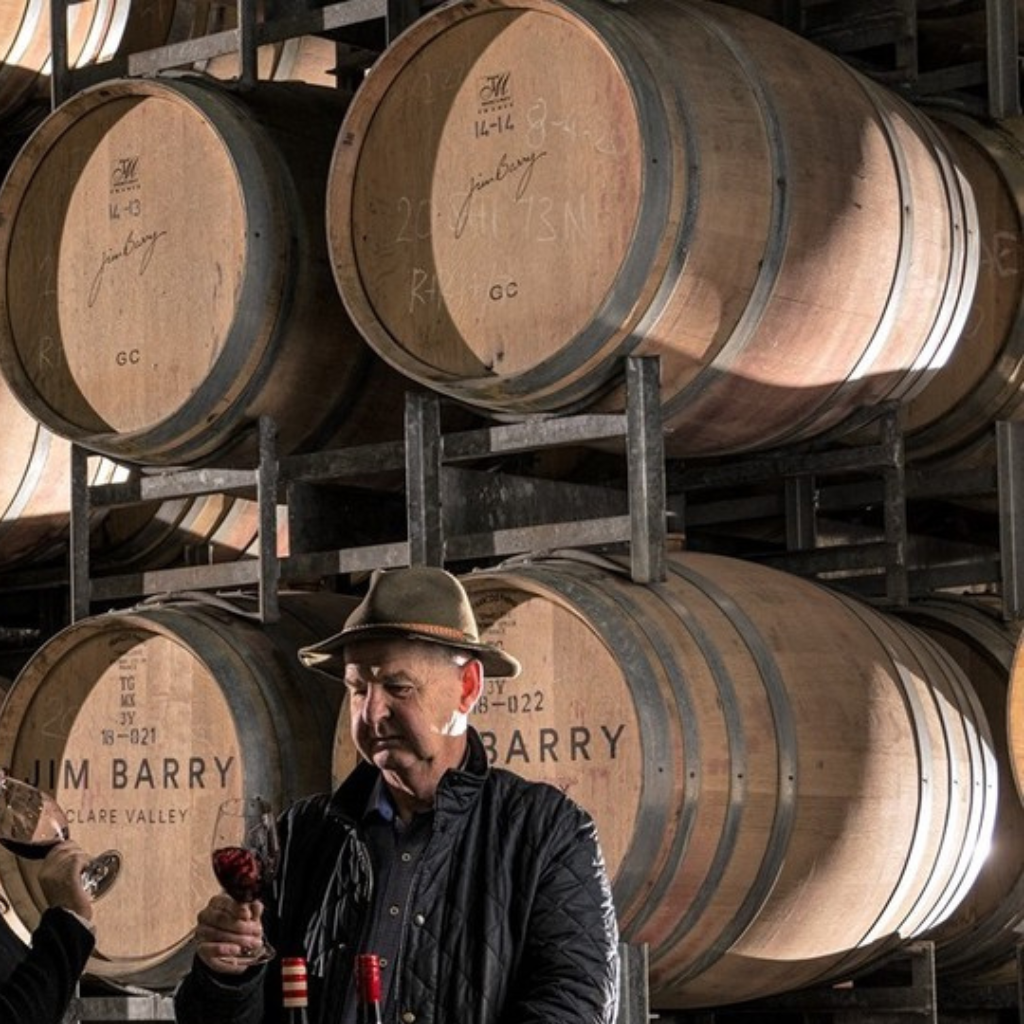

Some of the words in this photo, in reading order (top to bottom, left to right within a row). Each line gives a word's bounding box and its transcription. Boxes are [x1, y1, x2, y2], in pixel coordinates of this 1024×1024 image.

[489, 282, 519, 301] GC
[115, 349, 140, 366] GC
[484, 723, 626, 766] BARRY
[25, 759, 90, 790] JIM
[112, 756, 234, 790] BARRY
[67, 809, 118, 825] CLARE
[125, 808, 188, 825] VALLEY
